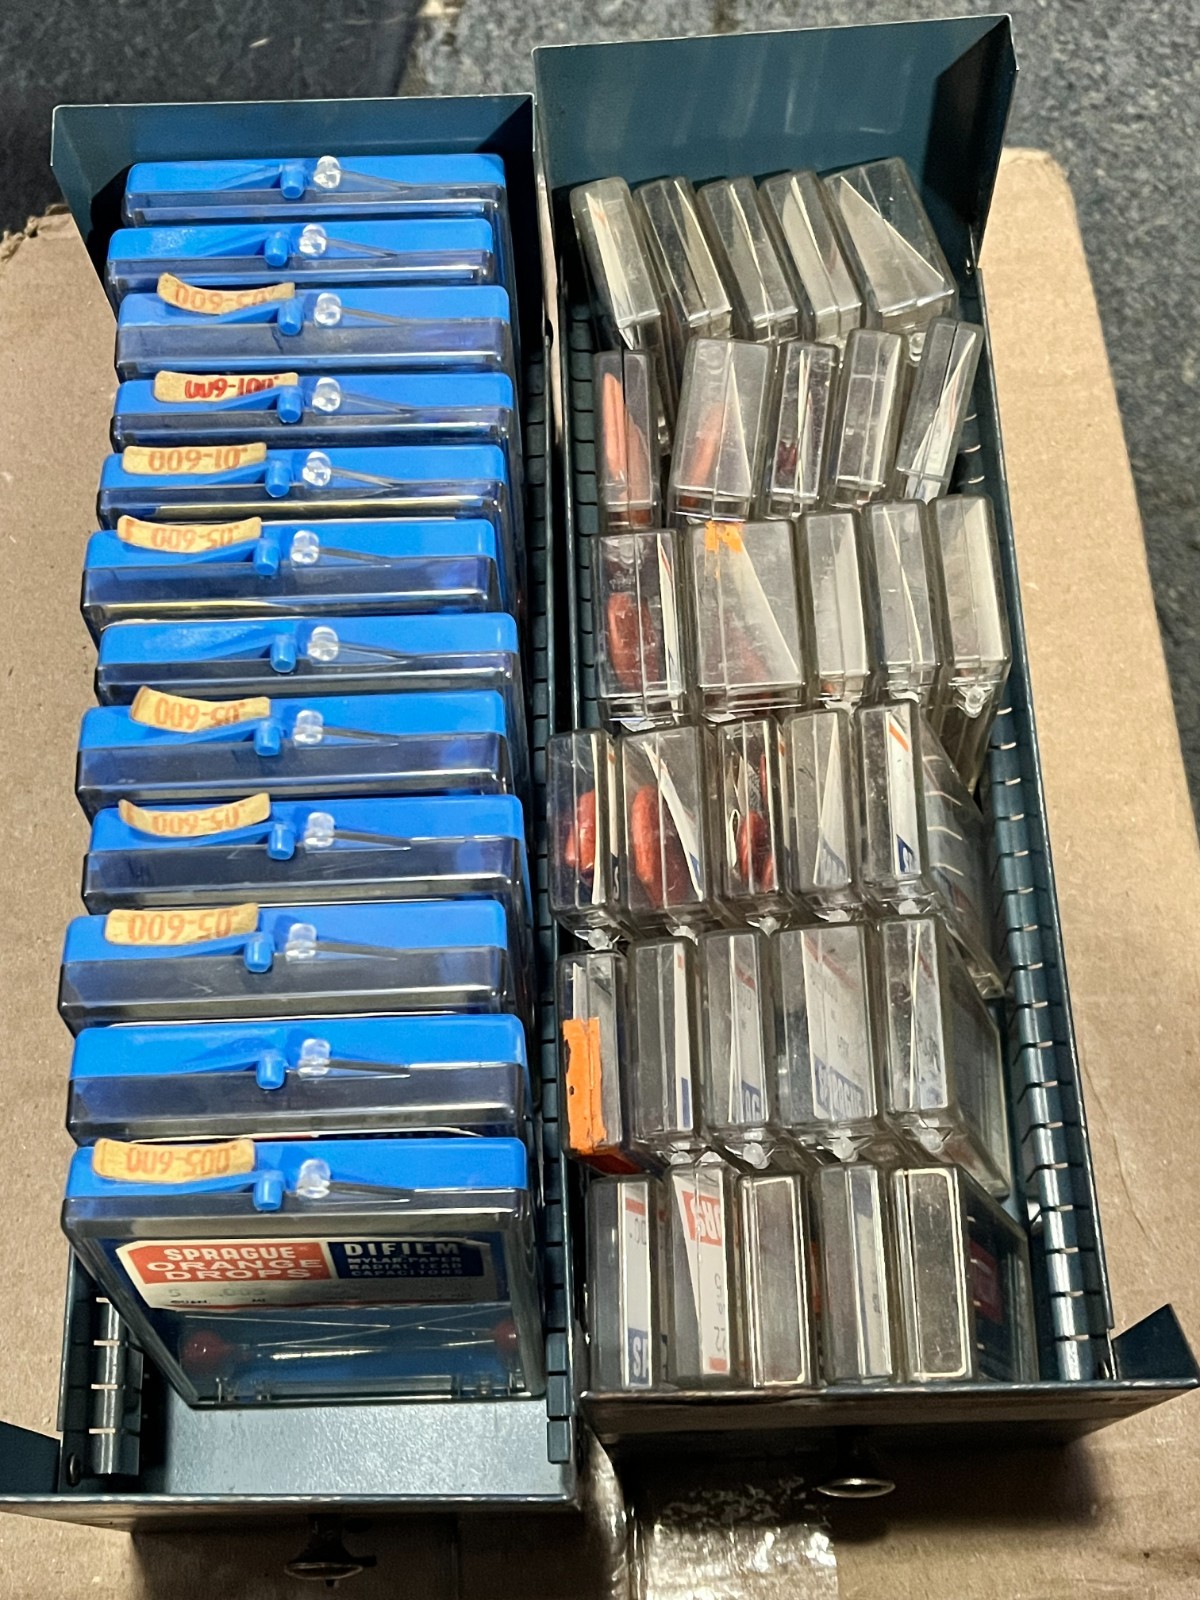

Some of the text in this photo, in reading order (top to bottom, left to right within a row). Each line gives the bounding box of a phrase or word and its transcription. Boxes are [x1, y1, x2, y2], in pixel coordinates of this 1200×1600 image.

[163, 1247, 296, 1261] SPRAGUE
[344, 1243, 460, 1256] DIFILM
[147, 1259, 322, 1271] ORANGE
[164, 1269, 311, 1280] DROPS
